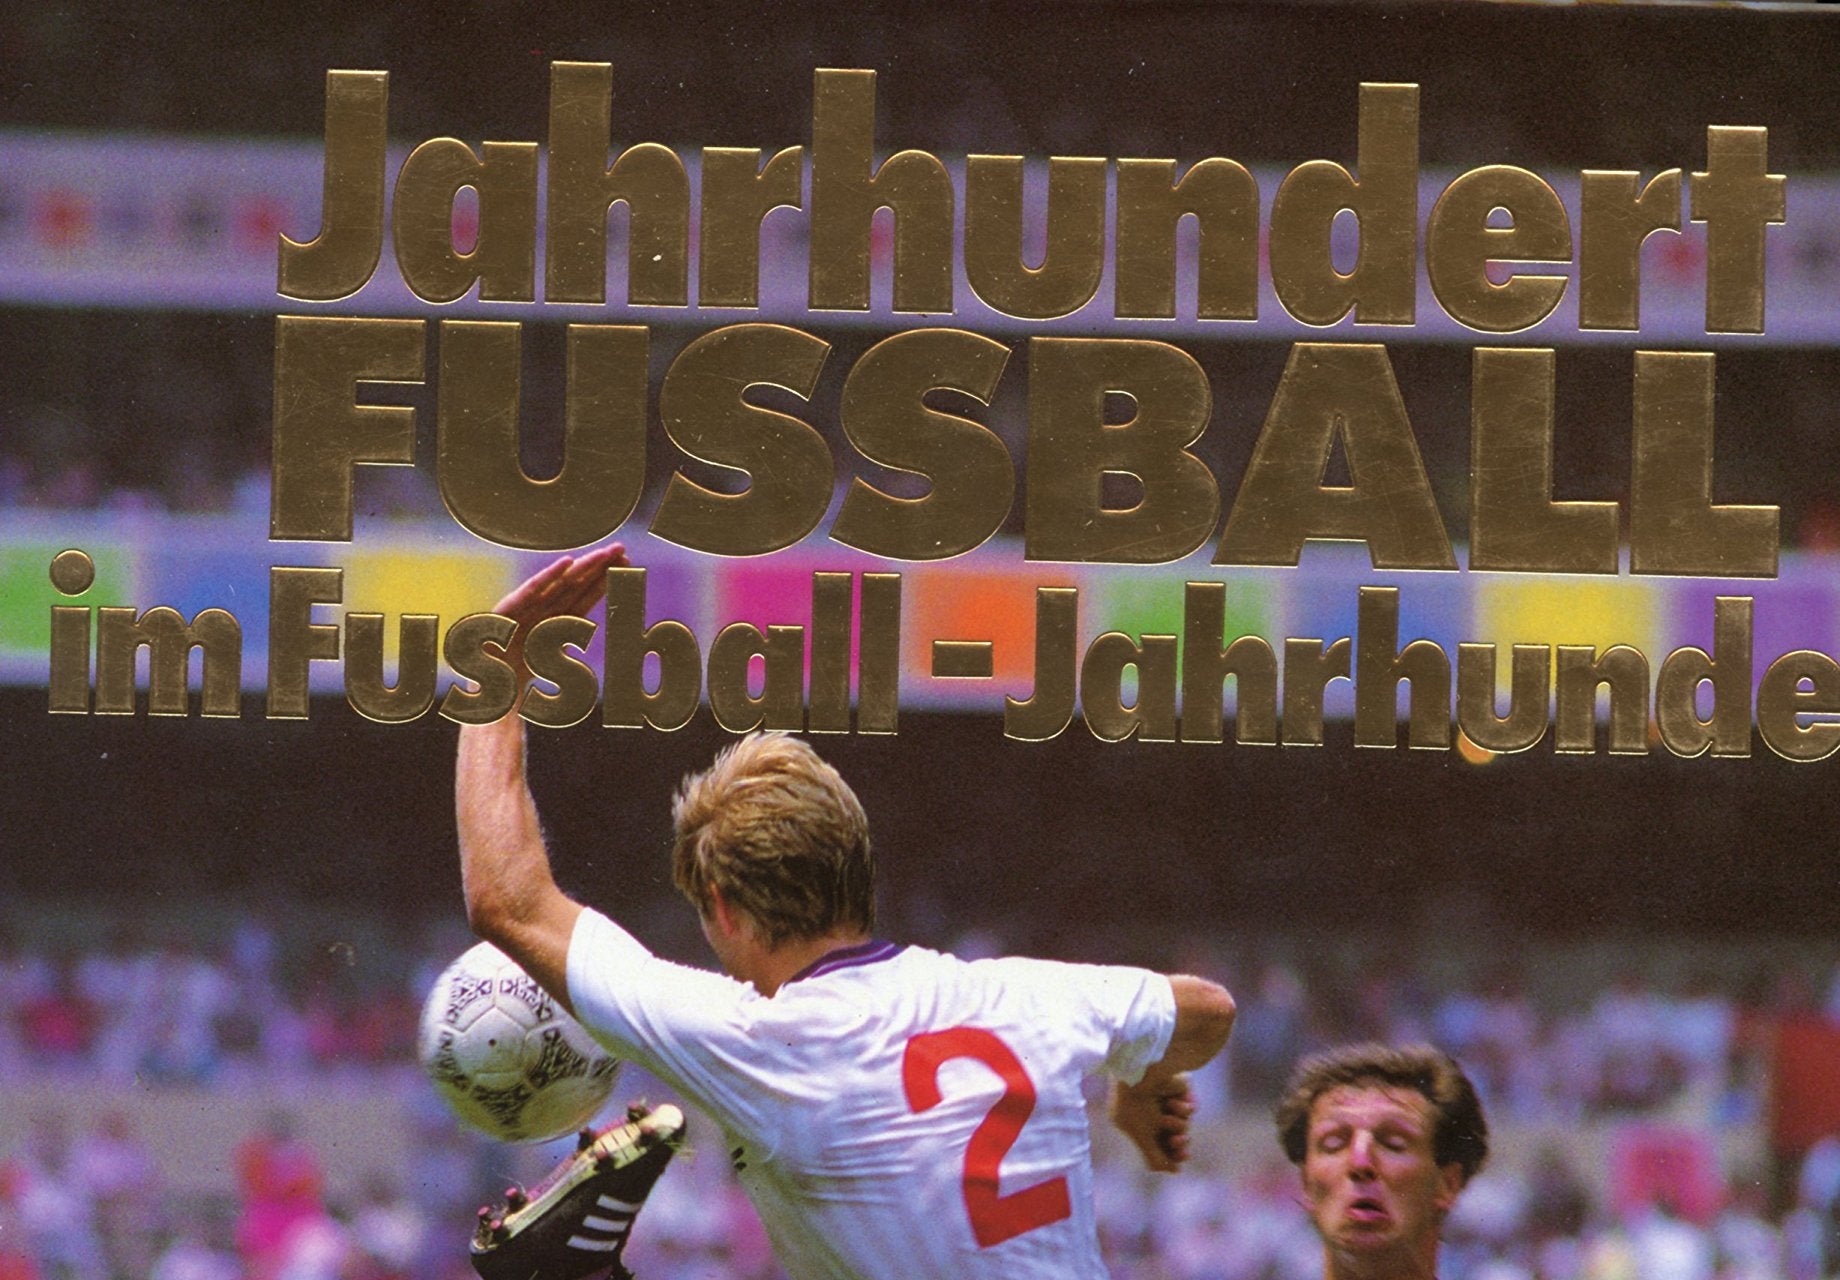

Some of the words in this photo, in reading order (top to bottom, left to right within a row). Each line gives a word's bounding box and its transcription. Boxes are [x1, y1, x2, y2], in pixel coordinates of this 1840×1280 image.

[277, 60, 1787, 335] Jahrhundert
[269, 314, 1781, 579] FUSSBALL
[48, 549, 241, 718] im
[266, 566, 901, 735] Fussball
[1003, 581, 1840, 763] Jahrhunde
[902, 1025, 1071, 1249] 2
